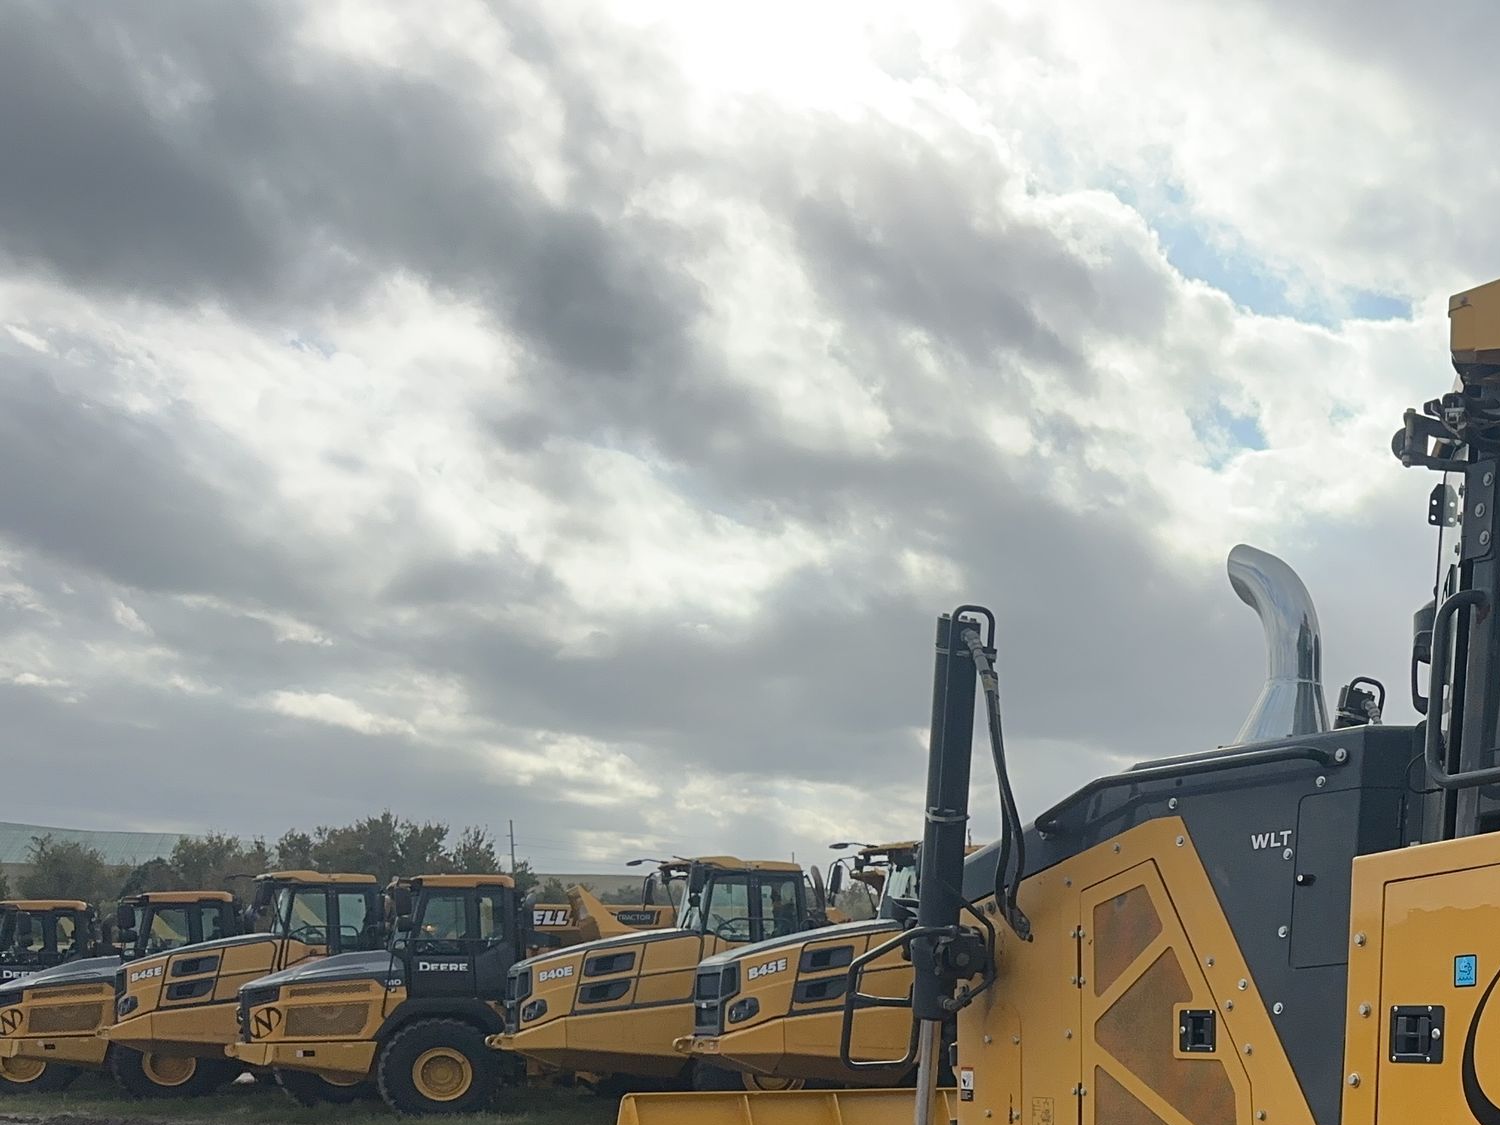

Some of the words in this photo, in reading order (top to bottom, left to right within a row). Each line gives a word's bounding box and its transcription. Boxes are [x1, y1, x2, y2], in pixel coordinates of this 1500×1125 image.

[1251, 830, 1292, 850] WLT
[533, 910, 568, 926] ELL
[131, 966, 163, 982] B45E
[419, 961, 469, 972] DEERE
[539, 966, 573, 982] B40E
[748, 958, 787, 980] B45E
